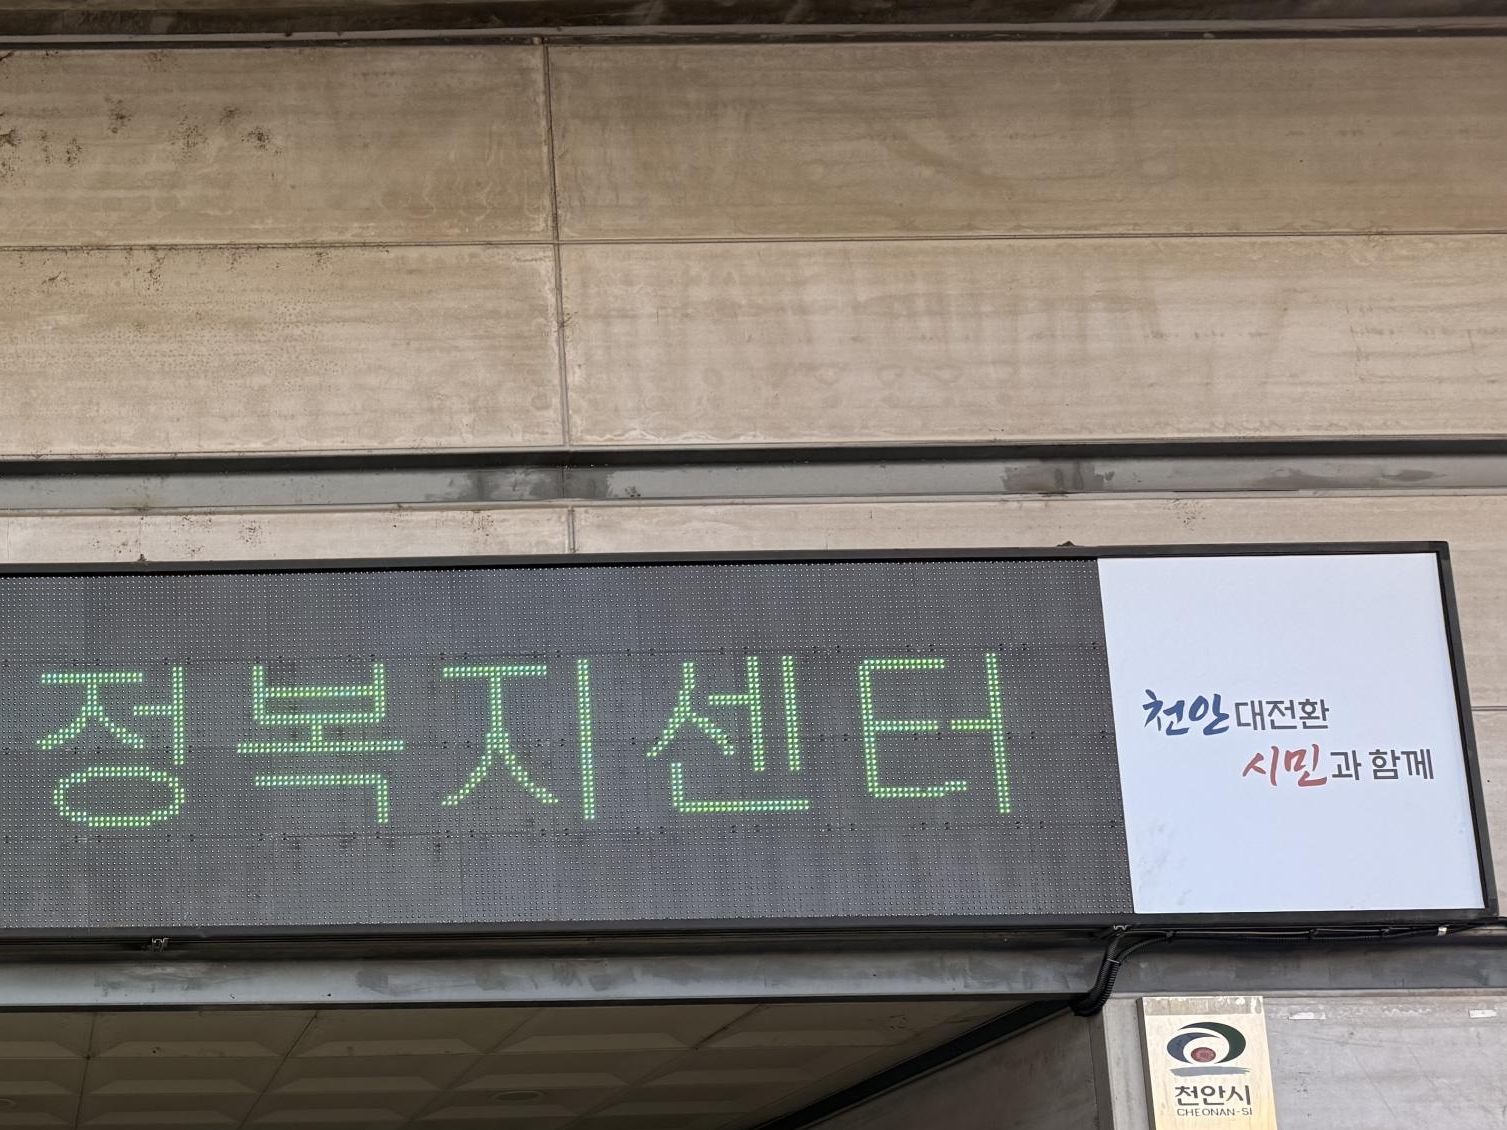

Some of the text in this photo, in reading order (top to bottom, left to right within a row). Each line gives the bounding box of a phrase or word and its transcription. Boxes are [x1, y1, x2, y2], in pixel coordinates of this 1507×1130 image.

[1142, 688, 1330, 735] 천안 대전환
[1370, 747, 1434, 780] 함께
[1175, 1085, 1251, 1106] 천안시
[1176, 1107, 1253, 1117] CHEONAN-SI
